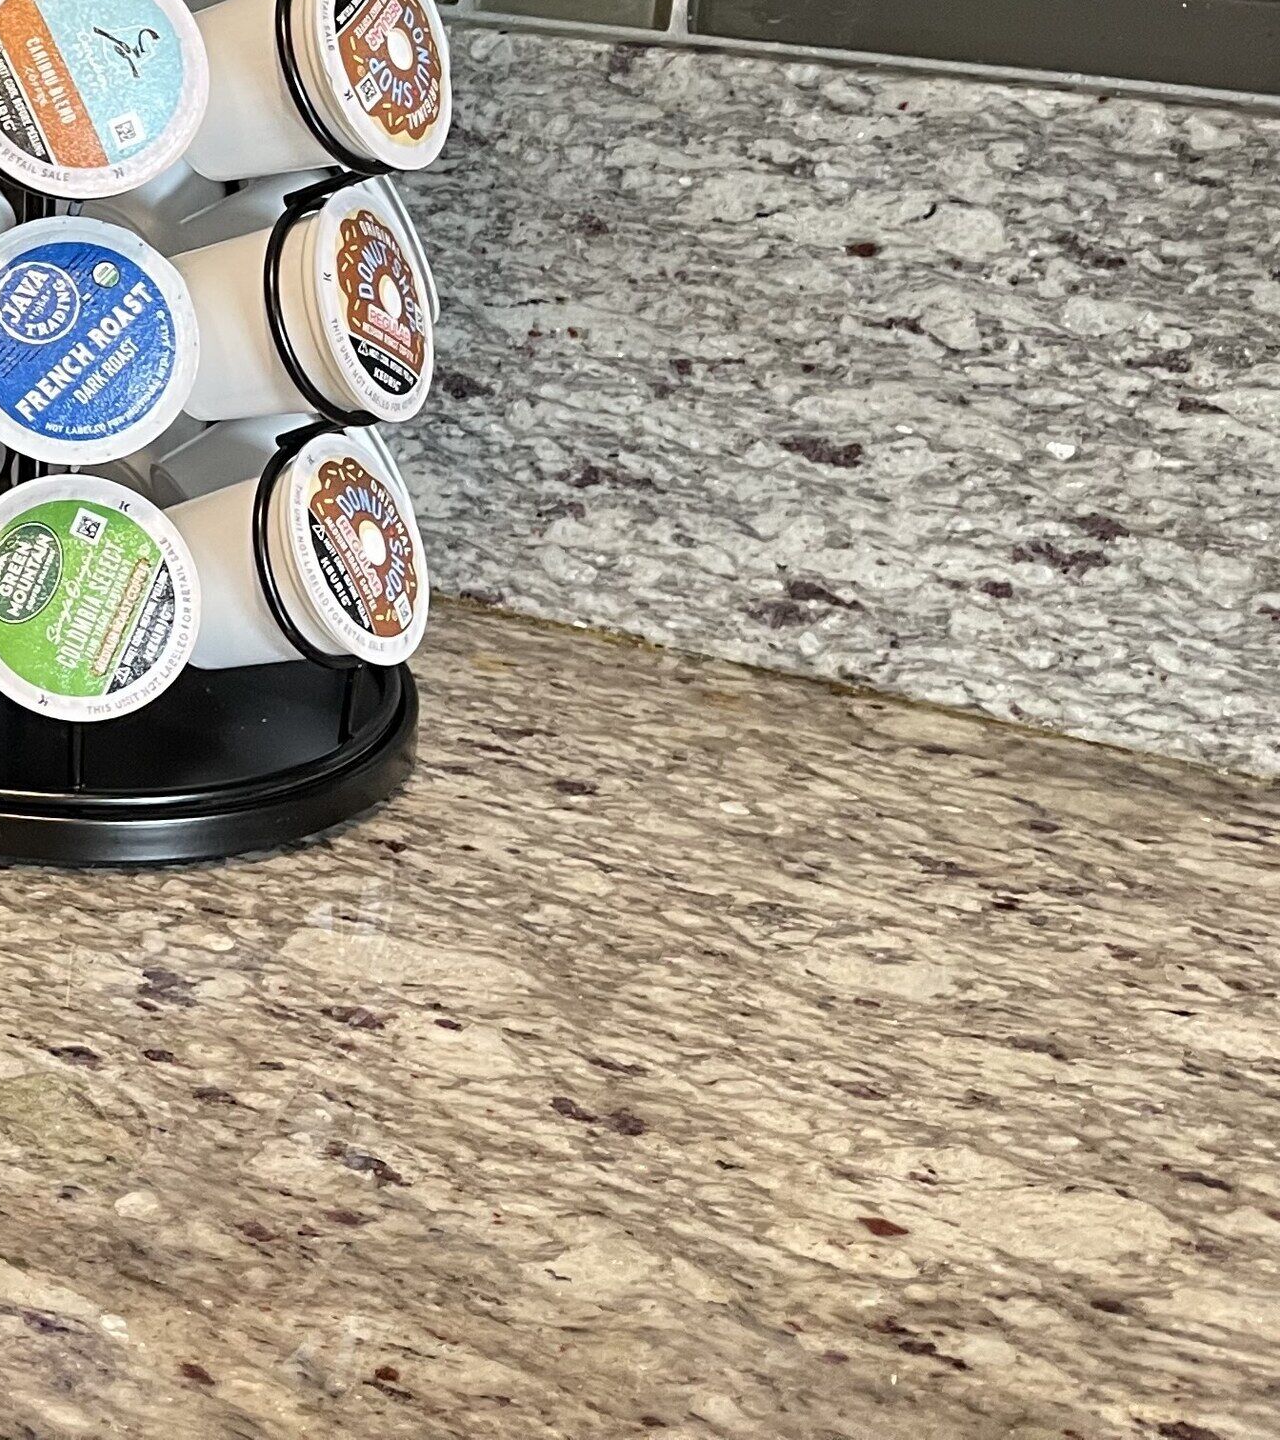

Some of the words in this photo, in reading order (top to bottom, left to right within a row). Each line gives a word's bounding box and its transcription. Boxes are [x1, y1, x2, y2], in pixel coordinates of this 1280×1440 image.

[369, 58, 414, 108] SHOP
[404, 7, 430, 101] DONUT
[405, 78, 439, 129] ORIGINAL
[3, 148, 37, 174] RETAIL
[40, 170, 70, 182] SALE
[0, 269, 49, 323] JAVA
[357, 240, 388, 300] DONUT
[25, 279, 71, 336] TRADING
[15, 343, 95, 421] FRENCH
[87, 282, 153, 350] ROAST
[73, 372, 109, 404] DARK
[101, 337, 139, 375] ROAST
[335, 486, 393, 529] DONUT
[385, 538, 405, 602] SHOP
[370, 480, 411, 555] ORIGINAL
[7, 533, 54, 616] MOUNTAIN
[159, 537, 180, 563] SALE
[325, 517, 346, 550] MEDIUM
[360, 577, 377, 610] COFFEE
[338, 516, 382, 597] REGULAR
[56, 593, 101, 668] COLOMBIA
[93, 541, 125, 594] SELECT
[176, 565, 191, 603] RETAIL
[320, 557, 352, 607] KEURIG
[161, 633, 189, 678] LABELED
[87, 704, 112, 714] THIS
